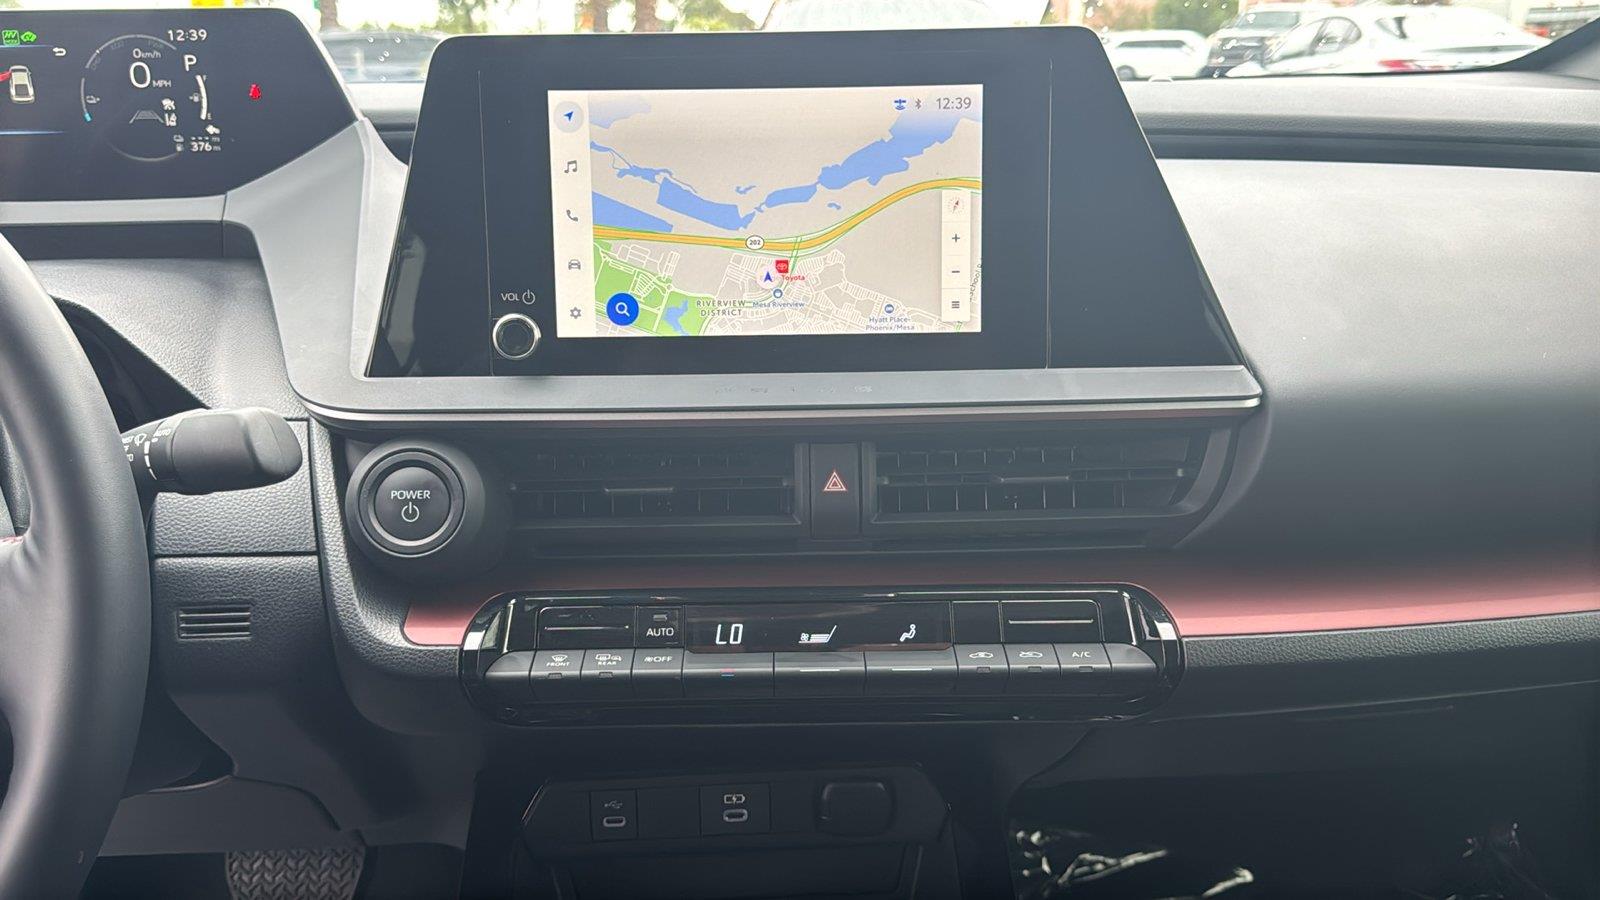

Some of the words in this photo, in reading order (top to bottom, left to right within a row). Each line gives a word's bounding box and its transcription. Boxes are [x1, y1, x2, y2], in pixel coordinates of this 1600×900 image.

[167, 29, 207, 41] 12:39
[183, 54, 197, 71] P
[129, 61, 151, 88] 0
[152, 80, 172, 88] MPH
[936, 97, 972, 110] 12:39
[191, 142, 213, 152] 376
[781, 275, 806, 283] Toyota
[501, 293, 520, 301] VOL
[696, 299, 747, 308] RIVERVIEW
[701, 309, 742, 317] DISTRICT
[868, 316, 889, 324] Hyatt
[390, 490, 431, 500] POWER
[646, 627, 674, 637] AUTO
[715, 623, 744, 645] LO
